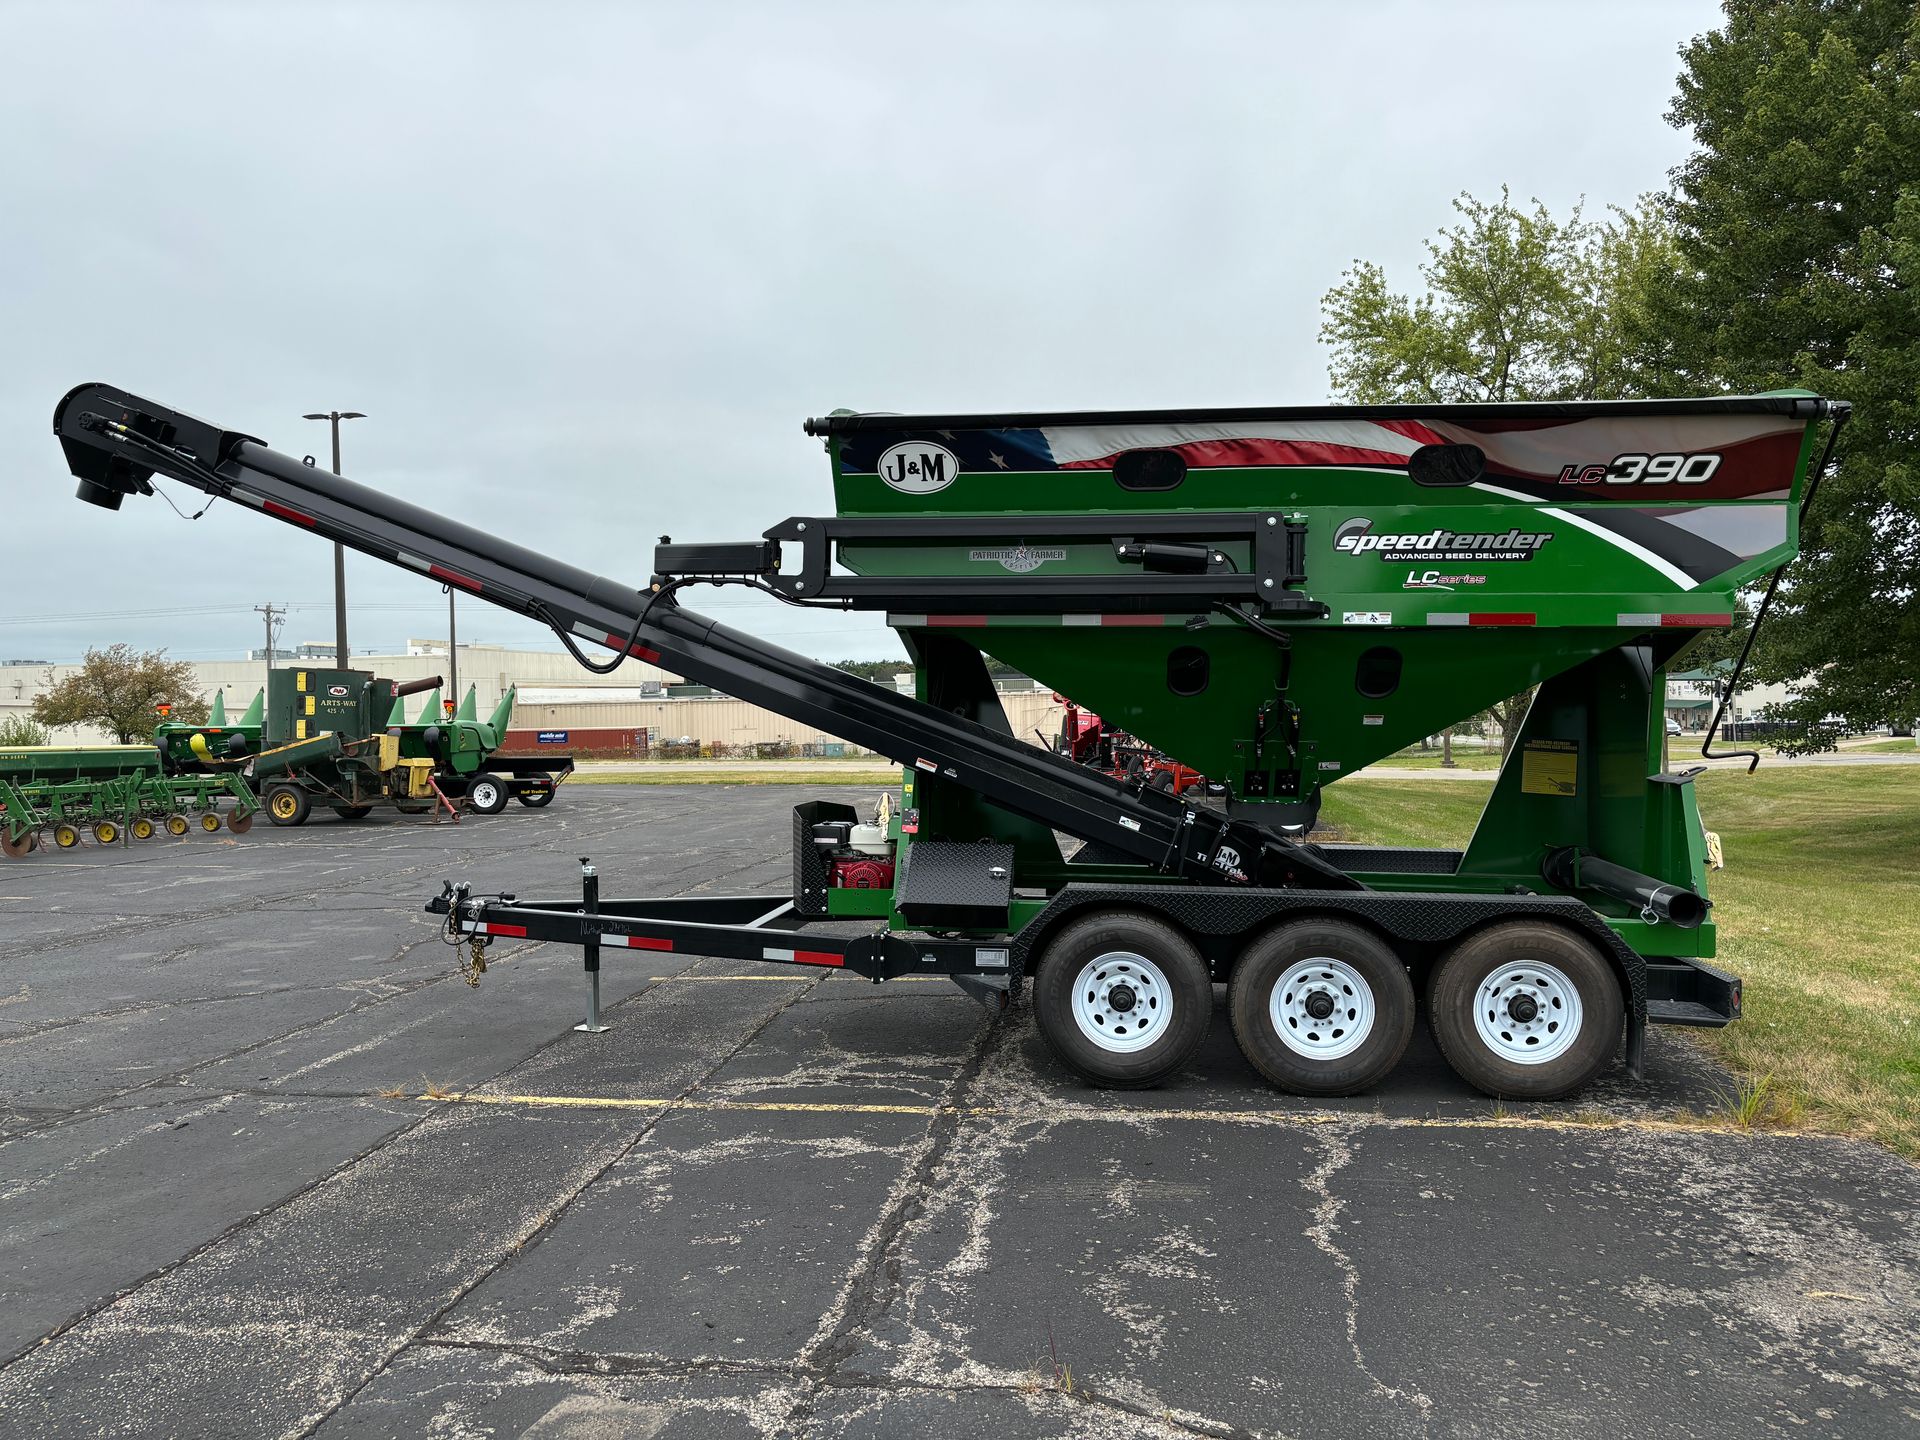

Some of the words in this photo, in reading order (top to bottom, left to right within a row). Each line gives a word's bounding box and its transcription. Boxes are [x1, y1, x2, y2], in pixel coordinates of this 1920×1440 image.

[886, 453, 946, 483] J&M
[972, 550, 1013, 559] PATRIOTIC
[1031, 550, 1063, 559] FARMER
[1384, 552, 1443, 560] ADVANCED
[1445, 552, 1473, 560] SEED
